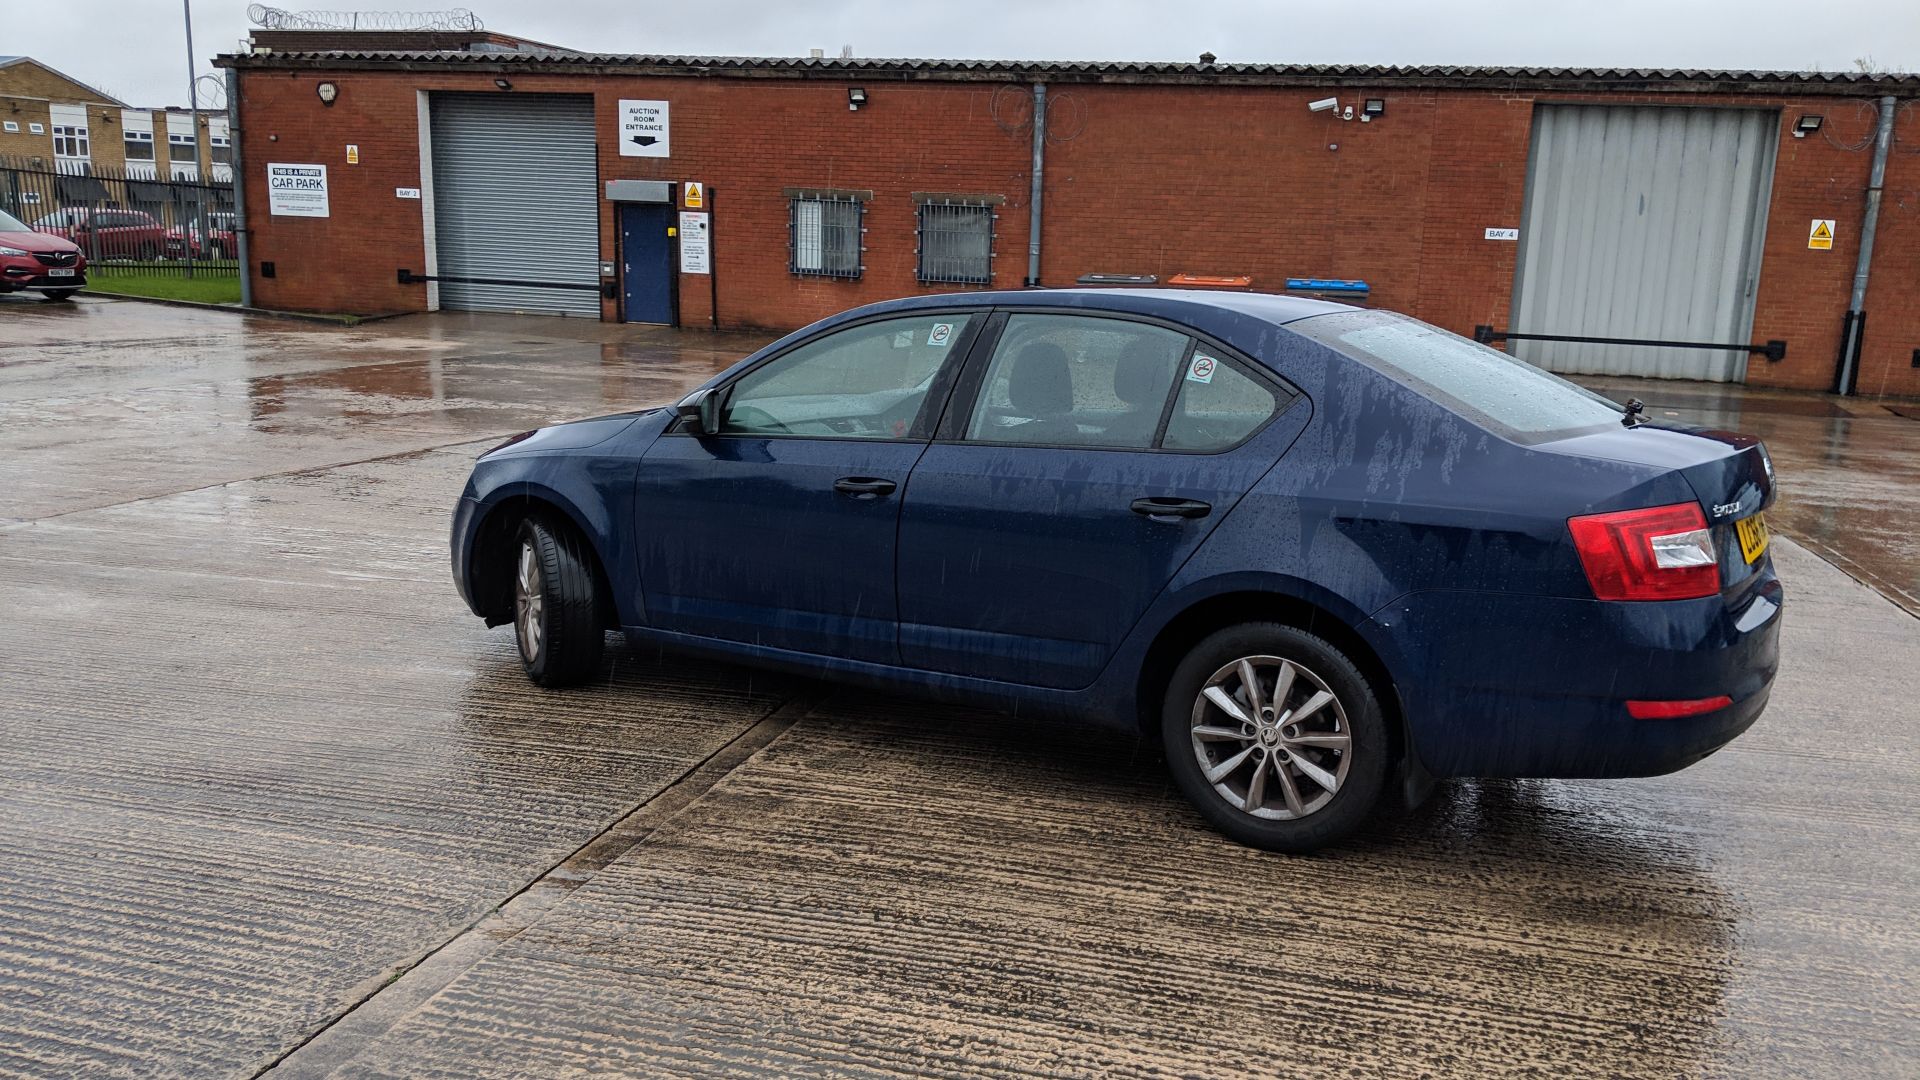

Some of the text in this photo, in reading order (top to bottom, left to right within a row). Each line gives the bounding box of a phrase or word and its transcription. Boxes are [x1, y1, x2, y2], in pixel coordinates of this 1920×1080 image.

[271, 177, 324, 189] CAR PARK
[1489, 230, 1506, 238] BAY
